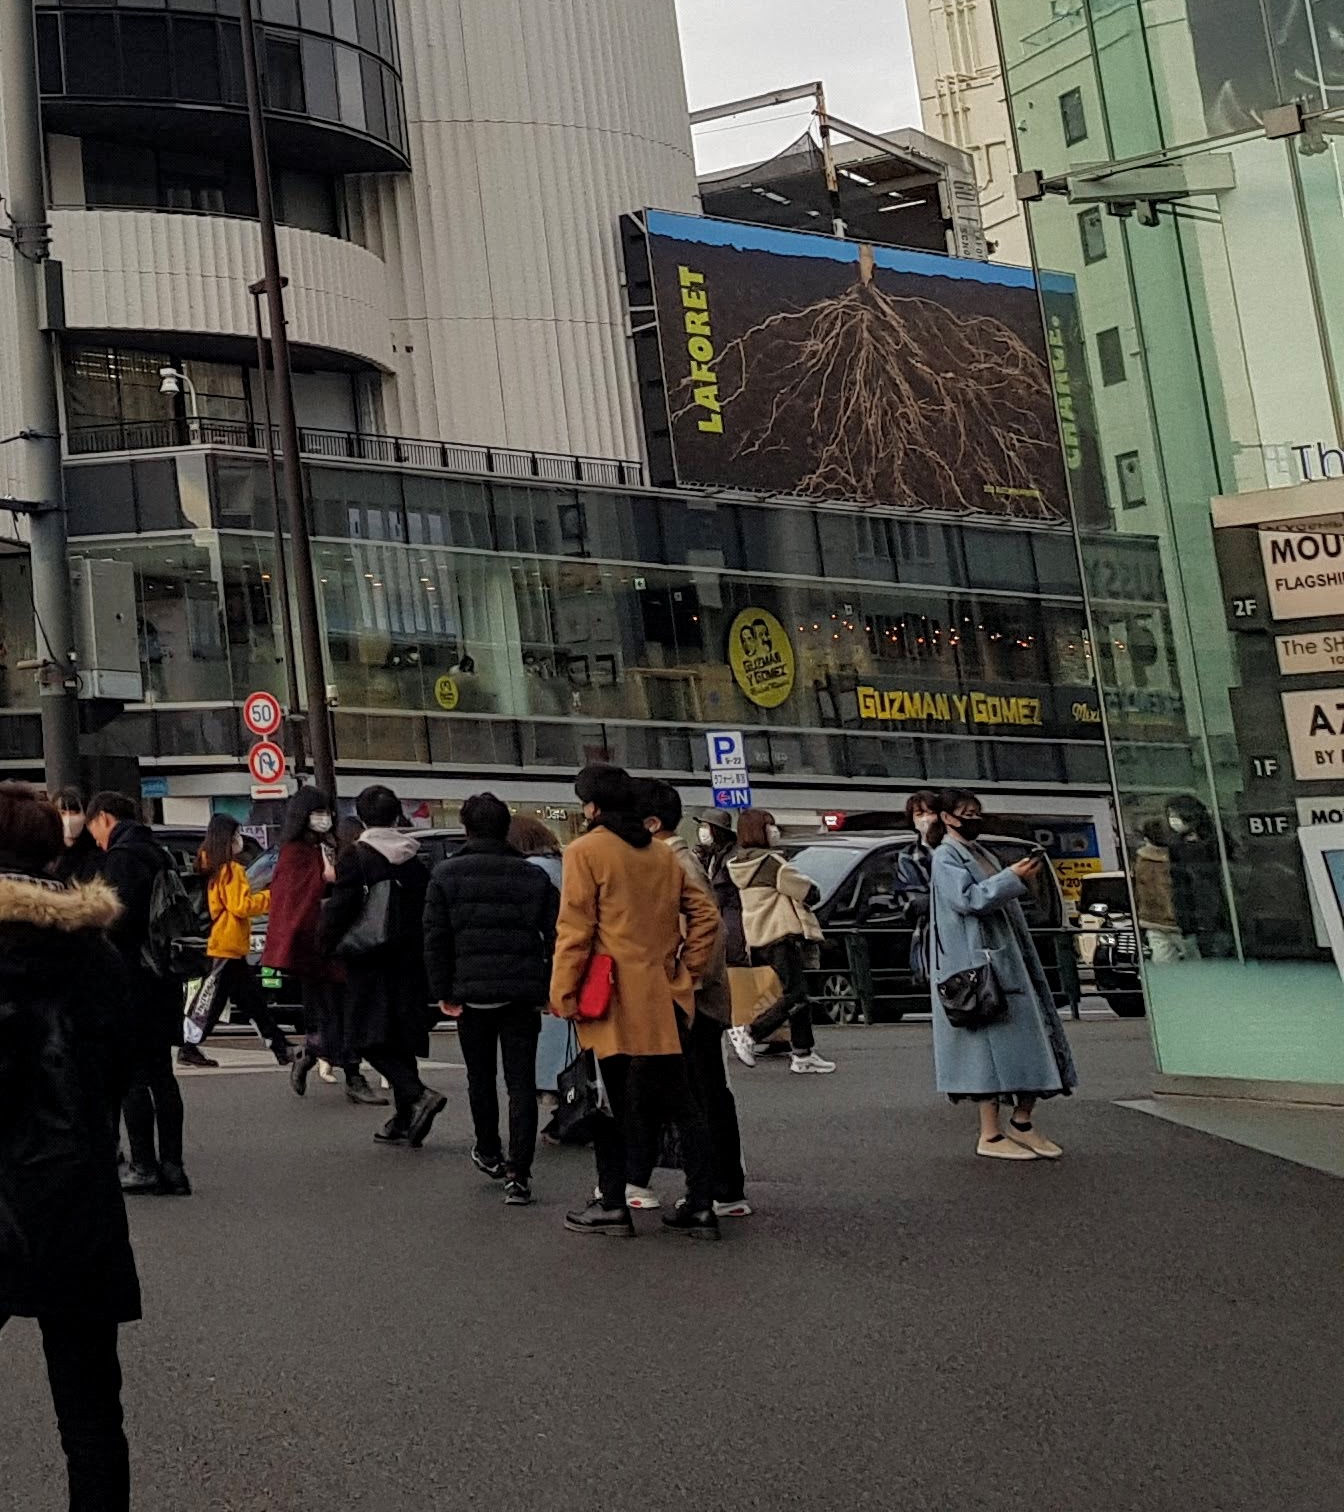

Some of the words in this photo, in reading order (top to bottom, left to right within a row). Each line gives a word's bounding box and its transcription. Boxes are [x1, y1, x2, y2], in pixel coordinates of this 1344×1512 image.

[678, 265, 724, 434] LAFORET
[1270, 533, 1344, 565] MOU
[1274, 571, 1344, 592] FLAGSHI
[1232, 598, 1257, 617] 2F
[1282, 639, 1317, 656] The
[251, 704, 272, 723] 50
[857, 686, 952, 721] GUZMAN
[952, 694, 968, 724] Y
[969, 691, 1043, 726] GOMEZ
[713, 736, 736, 765] P
[1314, 749, 1335, 766] BY
[1253, 759, 1278, 777] 1F
[730, 789, 749, 805] IN
[1248, 816, 1289, 834] B1F
[1311, 808, 1344, 824] MO
